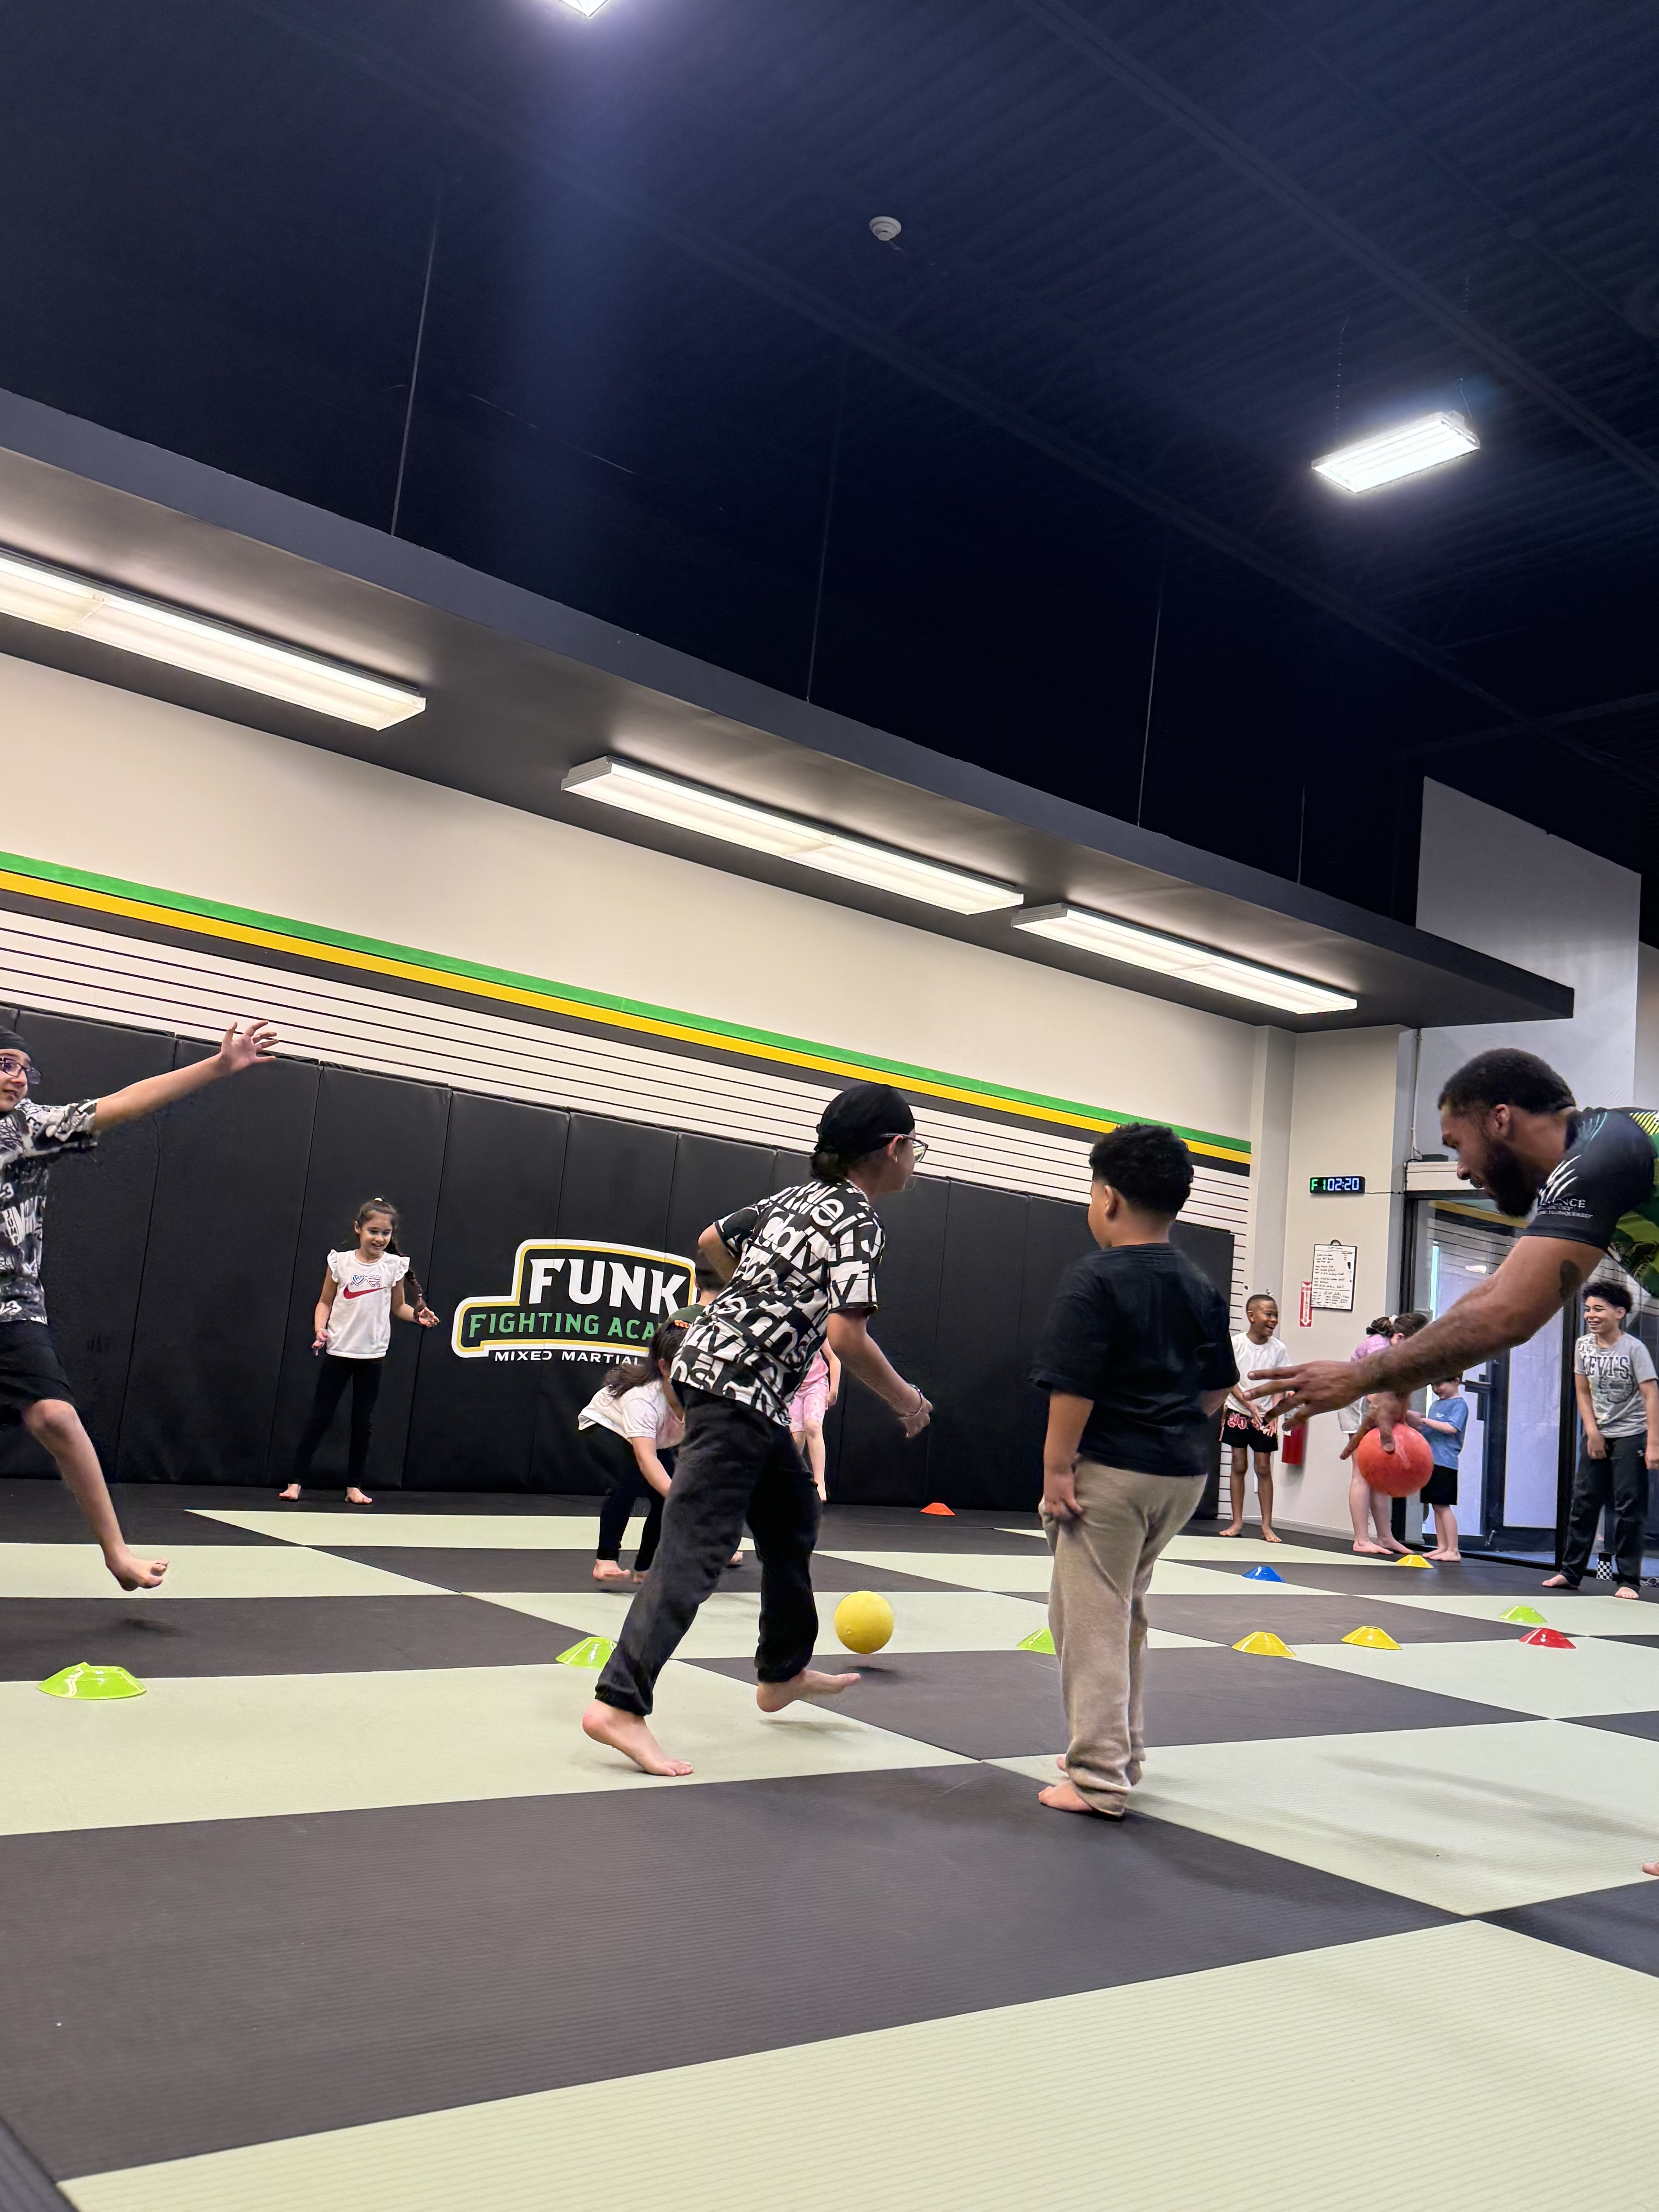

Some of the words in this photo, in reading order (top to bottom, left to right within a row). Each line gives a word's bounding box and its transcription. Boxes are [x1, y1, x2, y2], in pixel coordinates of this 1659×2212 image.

[1327, 1178, 1360, 1191] 02:20
[529, 1258, 687, 1316] FUNK
[469, 1312, 599, 1338] FIGHTING
[495, 1351, 553, 1362] MIXED
